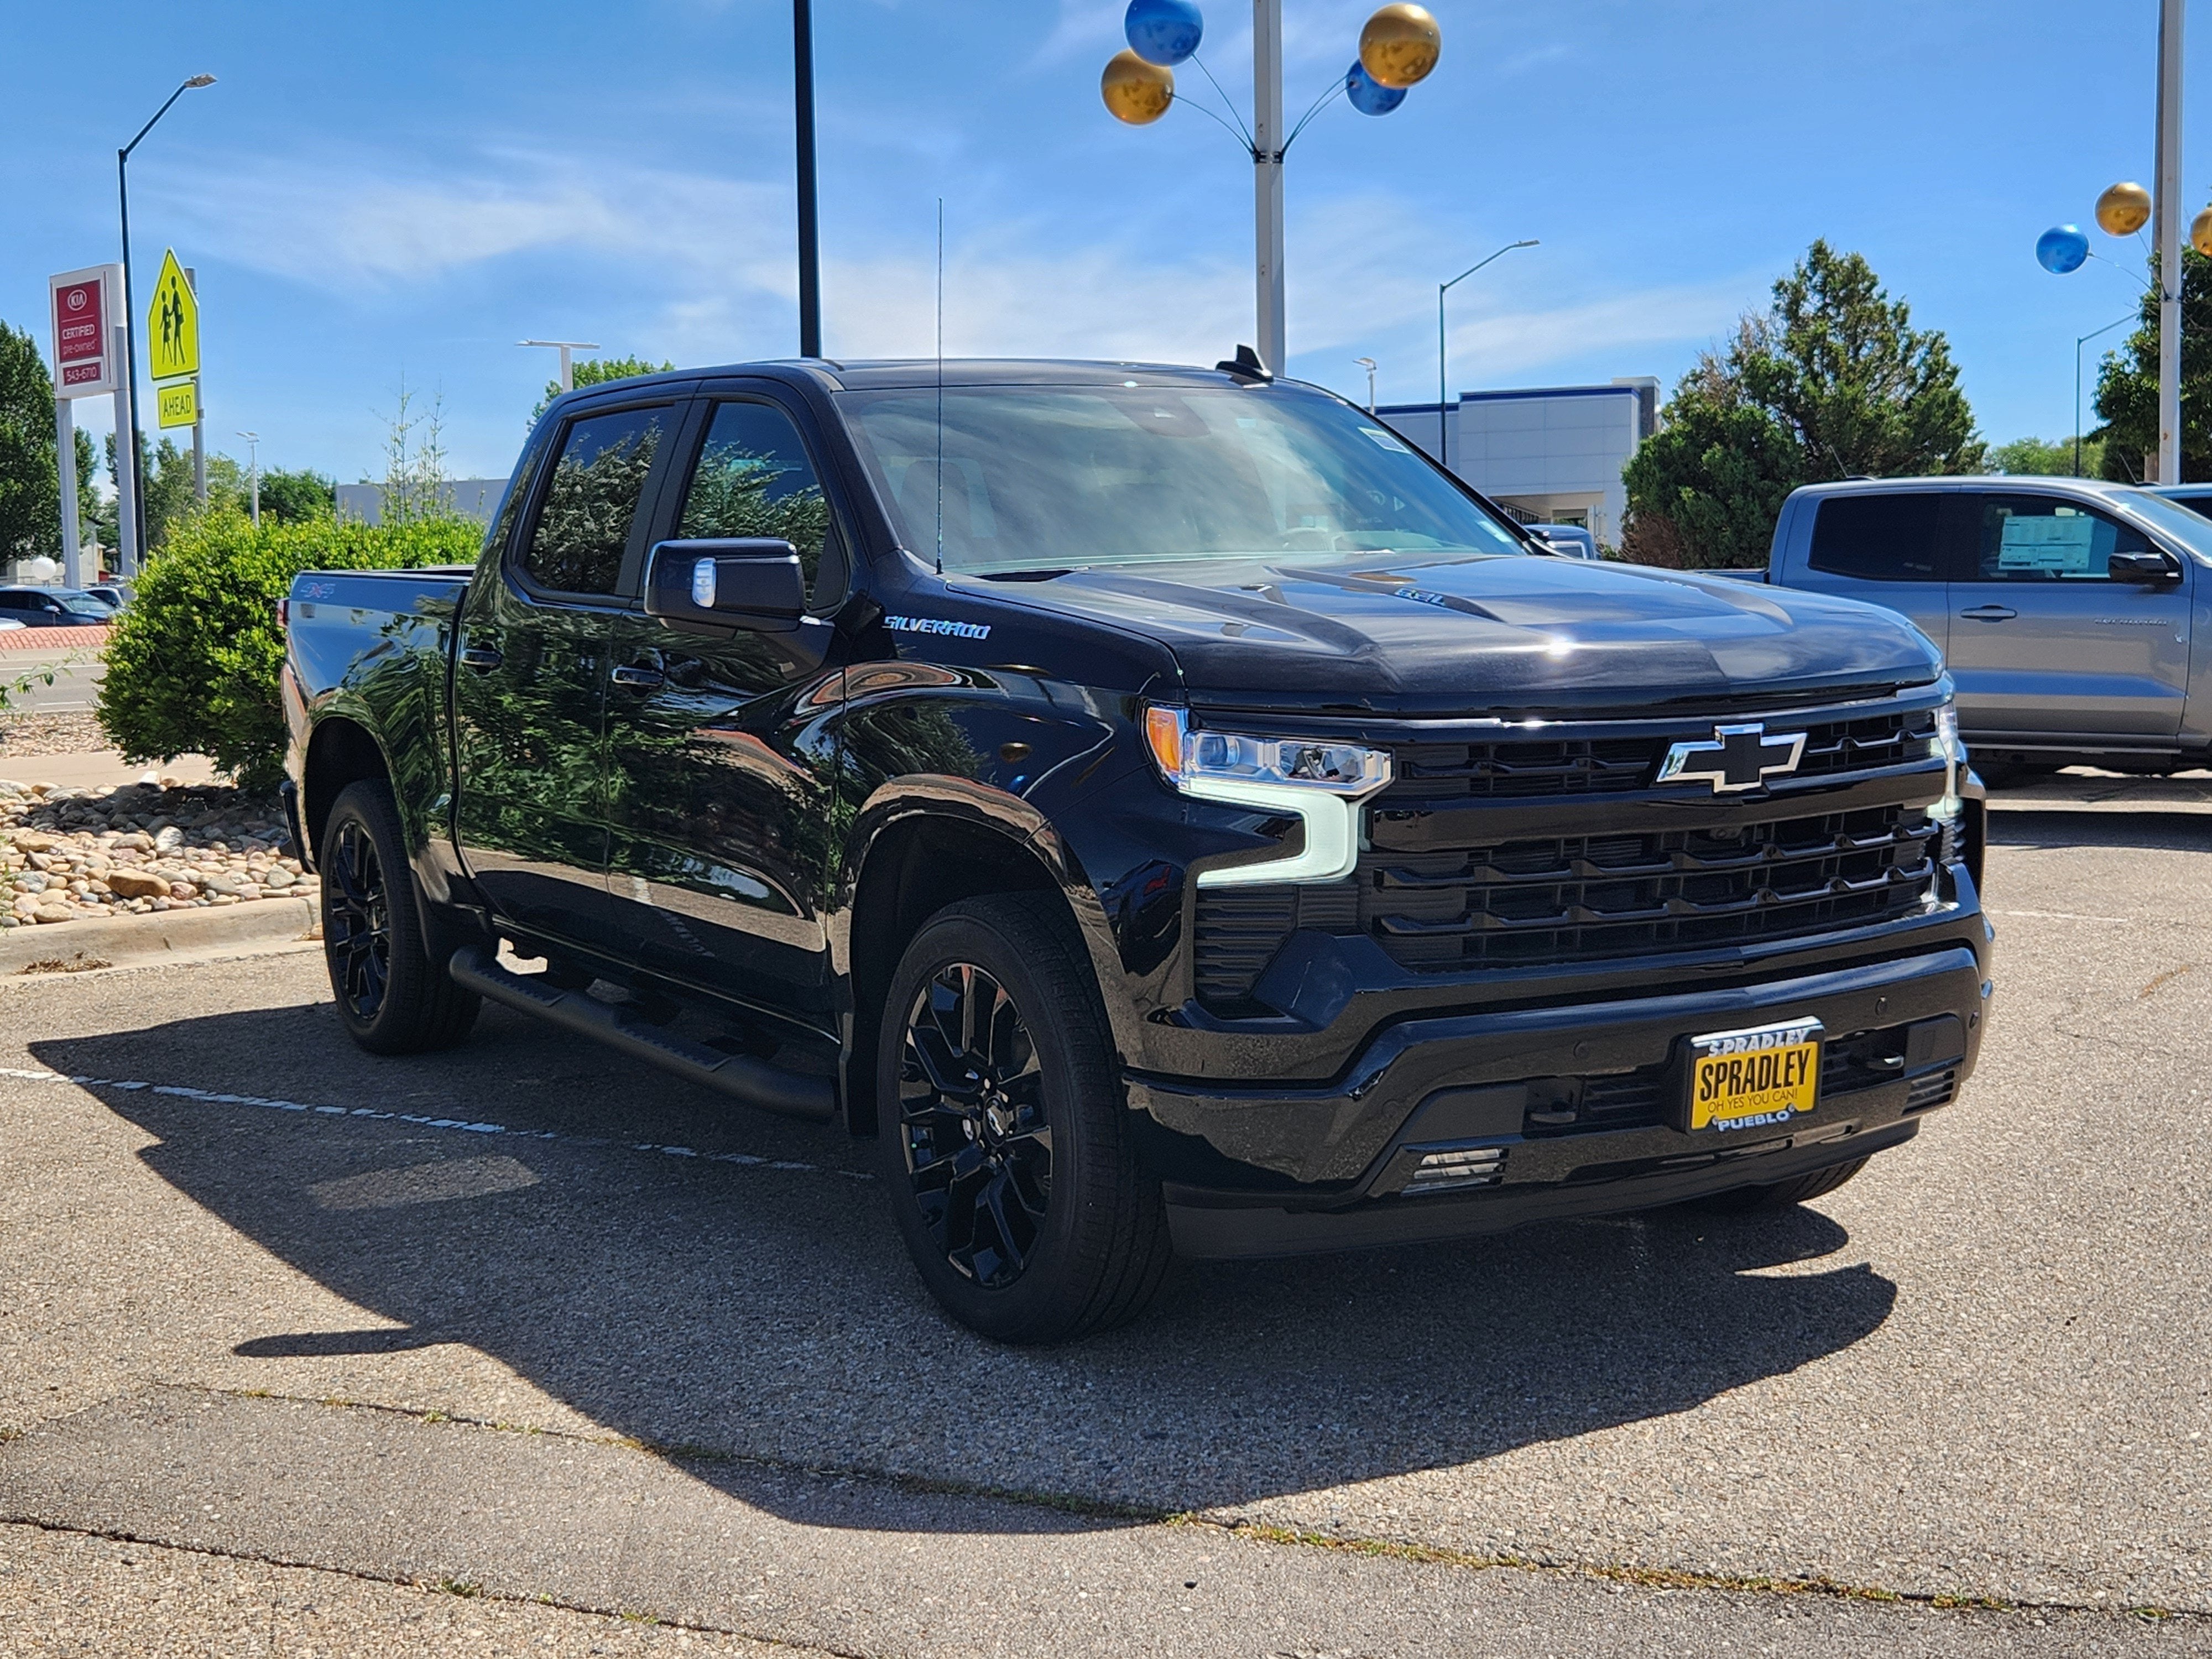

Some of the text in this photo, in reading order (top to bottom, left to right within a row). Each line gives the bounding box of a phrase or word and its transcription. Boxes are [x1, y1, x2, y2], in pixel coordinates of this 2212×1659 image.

[71, 293, 84, 306] KIA
[62, 324, 95, 340] CERTIFIED
[163, 394, 191, 418] AHEAD
[882, 615, 992, 640] SILVERADO
[1708, 1029, 1811, 1057] SPRADLEY
[1699, 1048, 1811, 1102] SPRADLEY
[1708, 1088, 1798, 1113] OH YES YOU CAN!
[1718, 1110, 1791, 1132] PUEBLO
